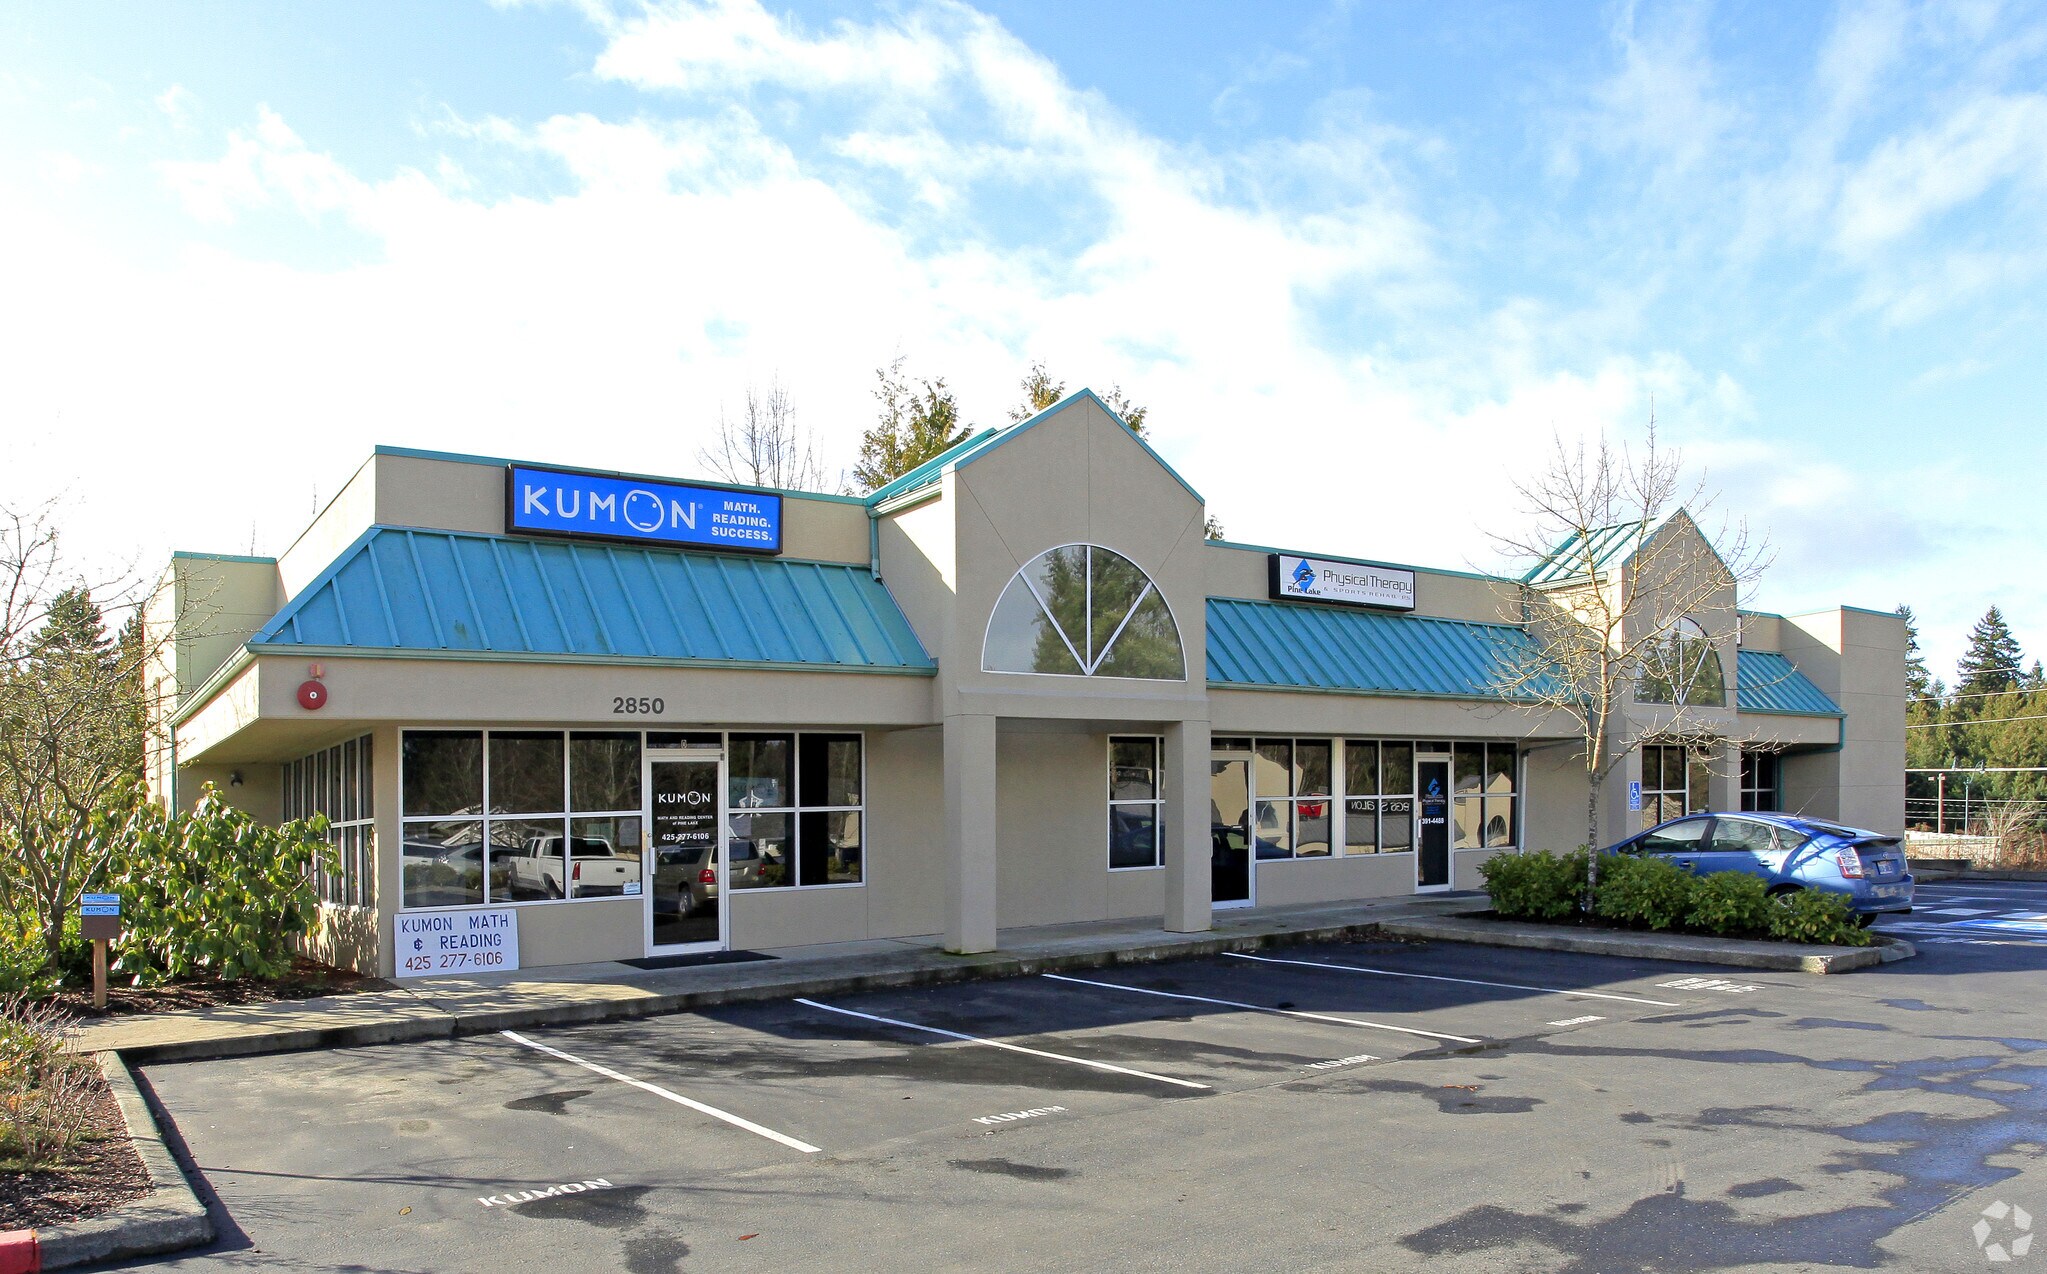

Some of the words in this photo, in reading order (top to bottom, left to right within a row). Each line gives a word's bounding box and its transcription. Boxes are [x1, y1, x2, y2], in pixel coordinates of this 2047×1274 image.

[524, 485, 696, 532] KUMON
[723, 501, 761, 514] MATH.
[712, 513, 772, 528] READING.
[711, 526, 773, 541] SUCCESS.
[1323, 569, 1368, 586] Physical
[1370, 575, 1413, 594] Therapy
[1304, 588, 1321, 596] Lake
[613, 696, 665, 714] 2850
[658, 790, 711, 805] KUMON
[661, 832, 710, 841] 425-277-6106
[401, 917, 453, 933] KUMON
[469, 914, 509, 929] MATH
[440, 933, 502, 949] READING
[405, 955, 431, 971] 425
[440, 951, 503, 968] 277-6106
[477, 1178, 613, 1207] KUMON
